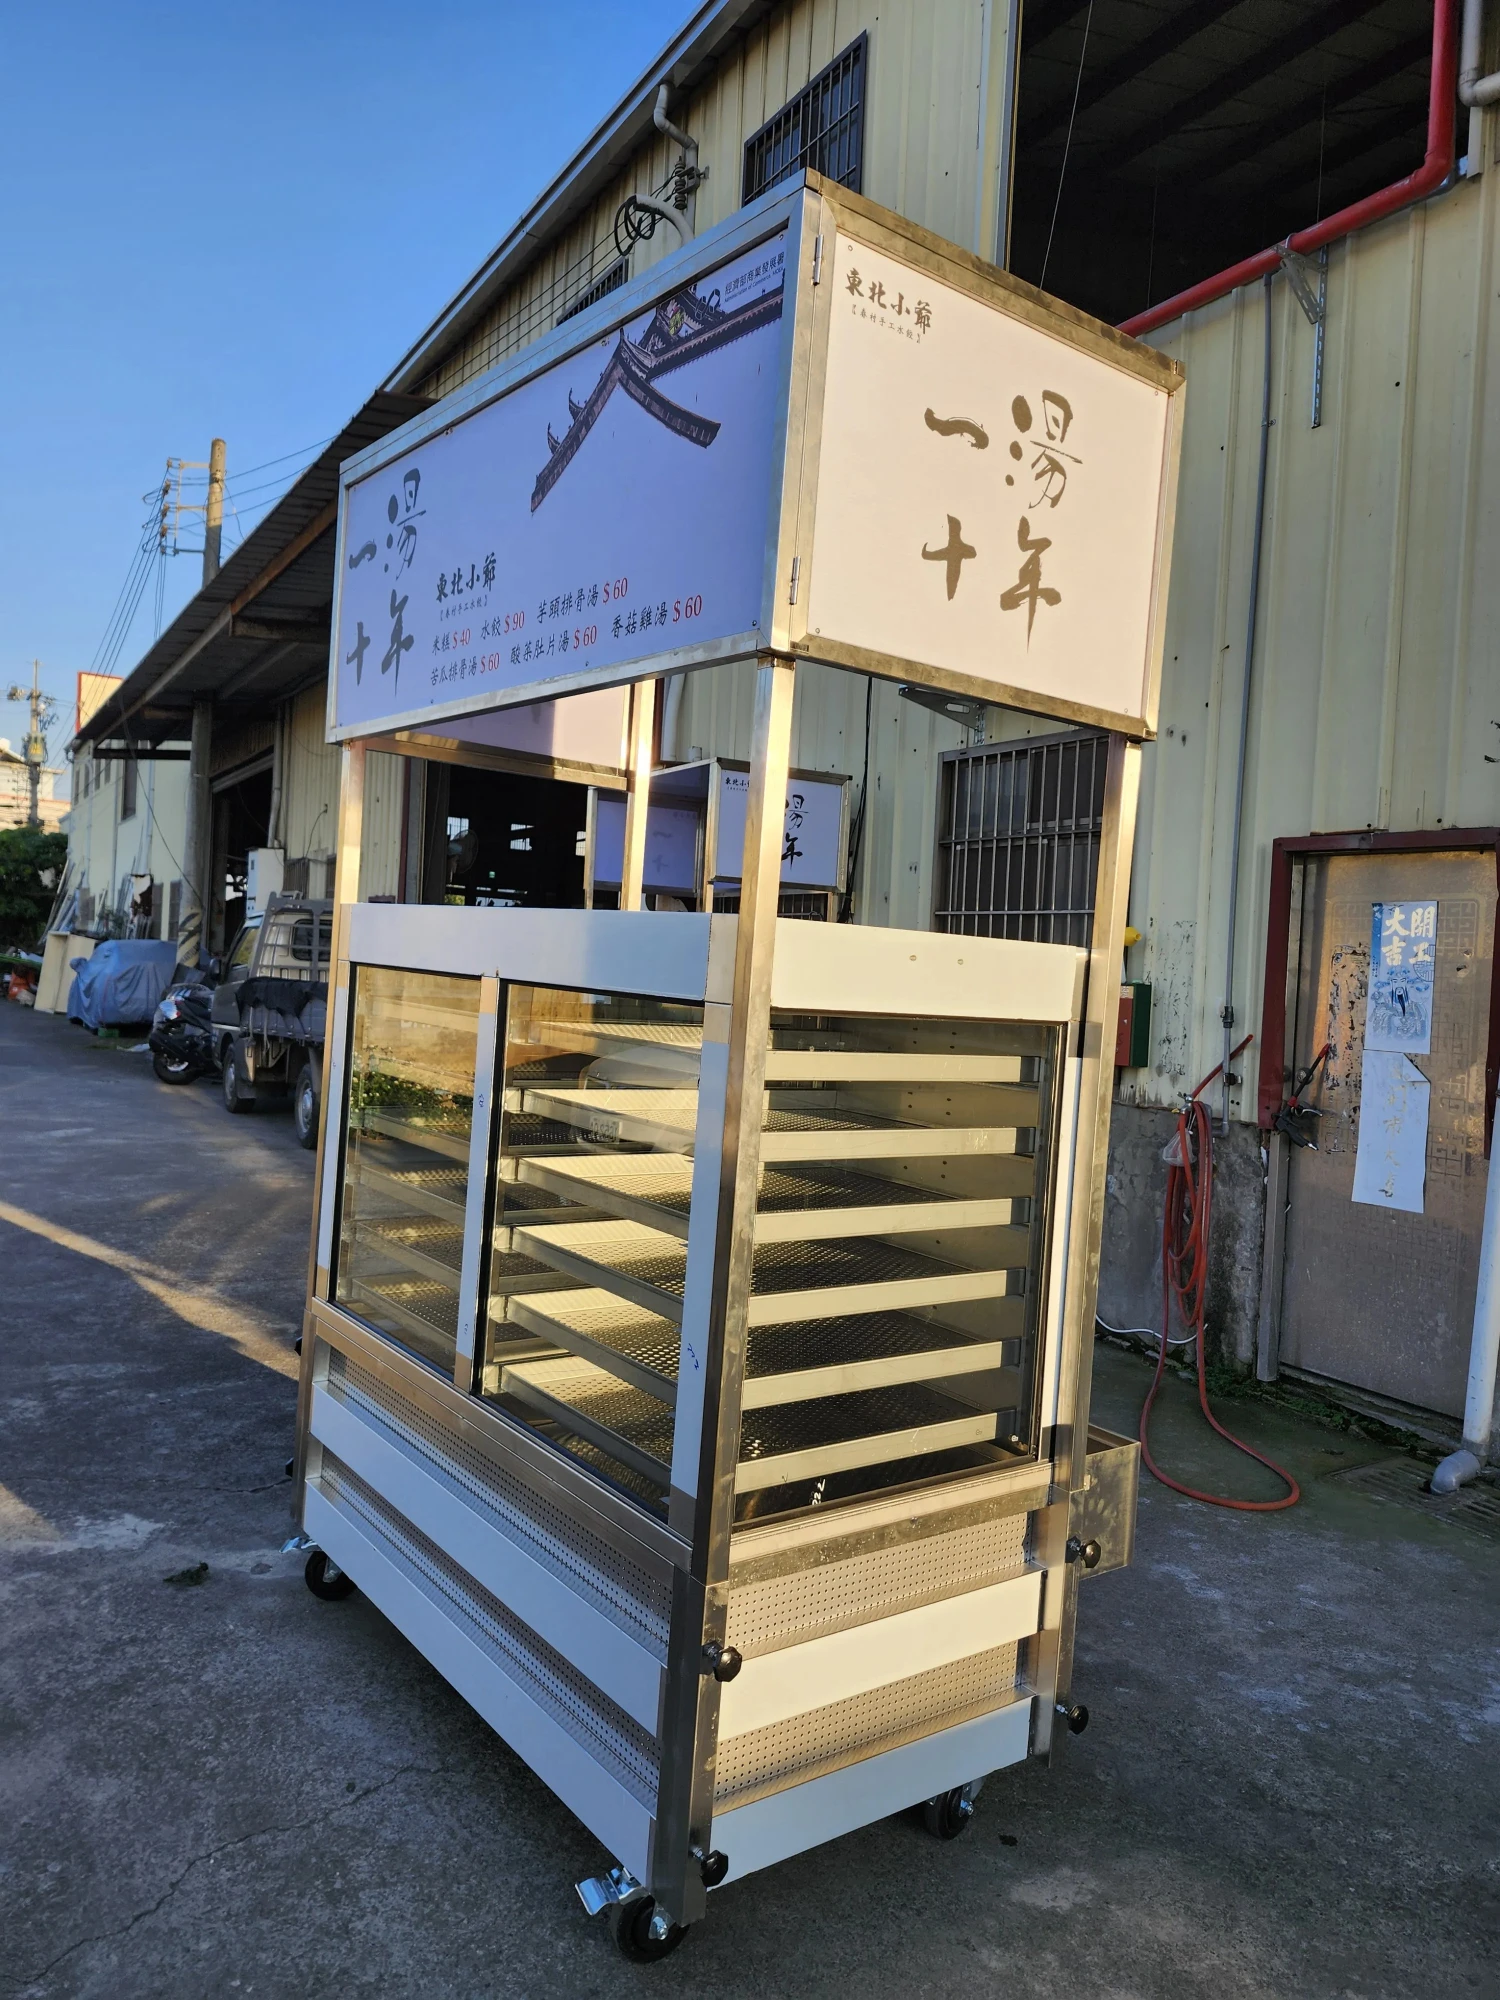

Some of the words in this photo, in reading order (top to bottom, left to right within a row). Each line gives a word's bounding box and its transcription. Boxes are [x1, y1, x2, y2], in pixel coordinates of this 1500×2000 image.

[845, 267, 933, 335] 東北小爺
[436, 551, 497, 603] 東北小爺
[480, 615, 501, 640] 水餃
[536, 583, 599, 625] 芋頭排骨湯
[430, 655, 477, 686] 苦瓜排骨湯
[610, 601, 668, 640] 香菇雞湯
[725, 777, 750, 788] 東北小
